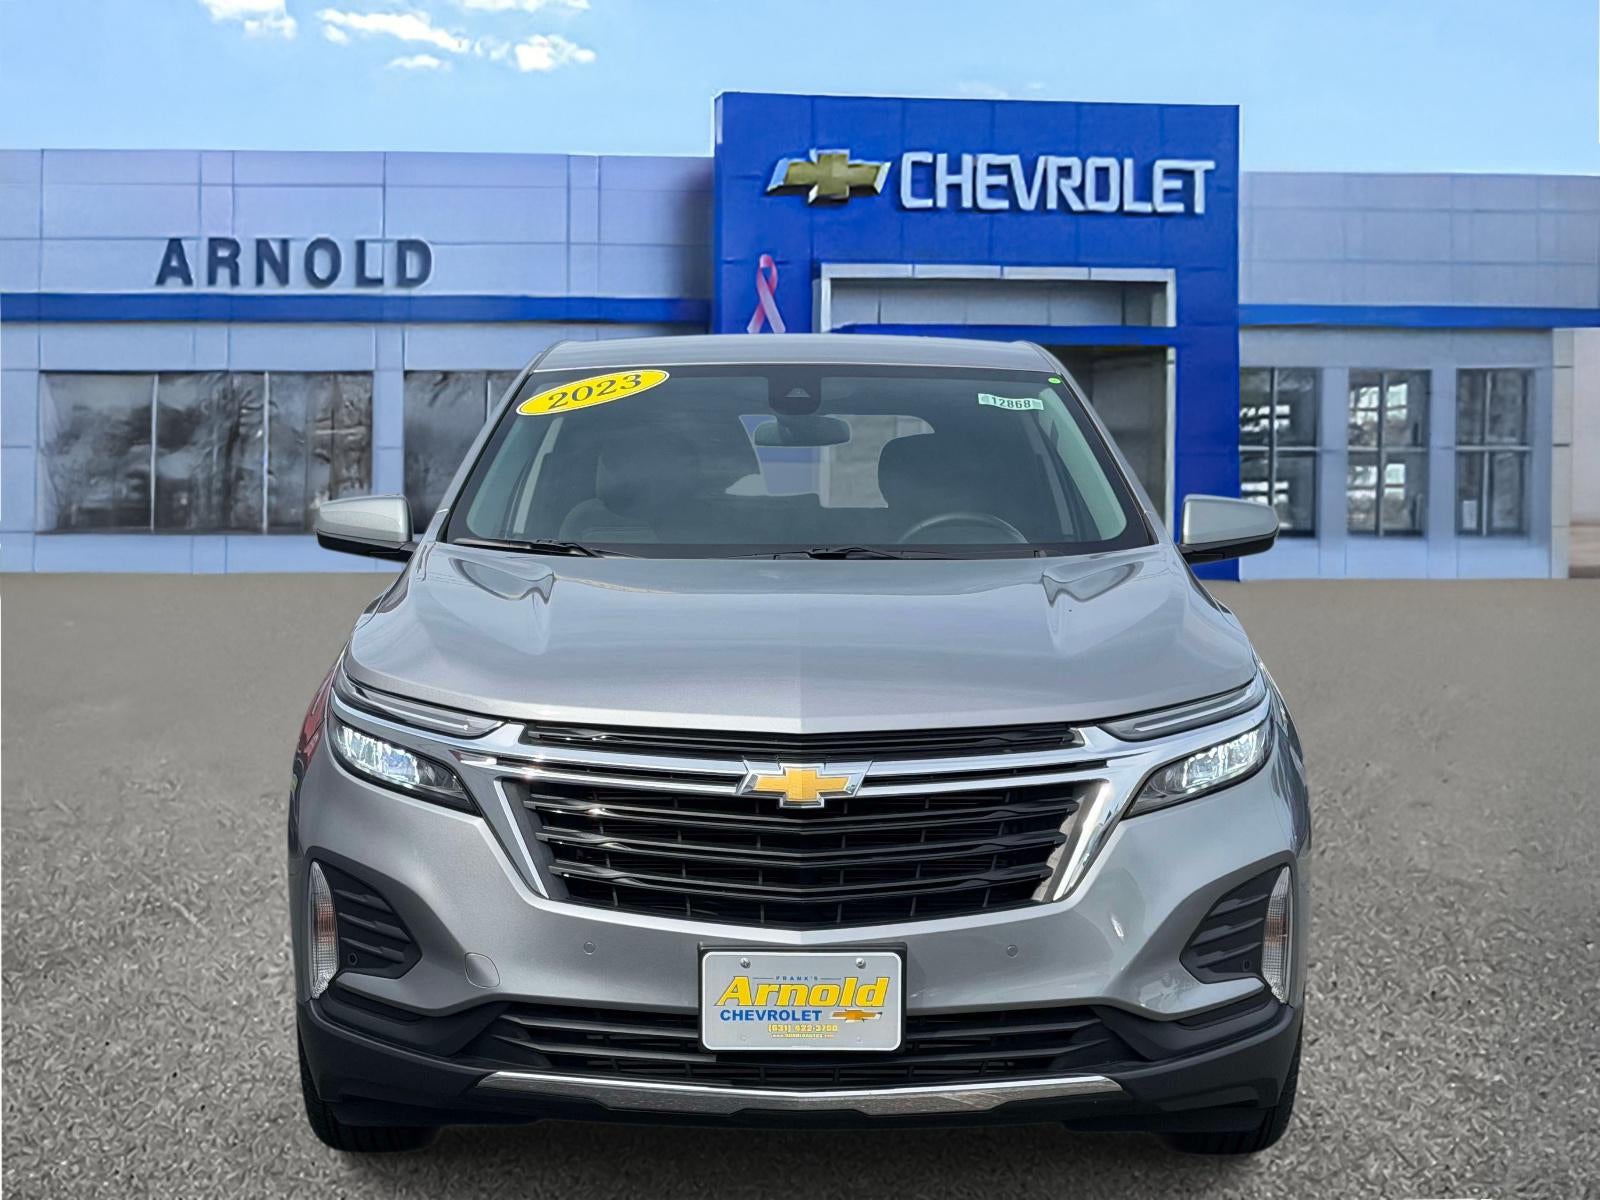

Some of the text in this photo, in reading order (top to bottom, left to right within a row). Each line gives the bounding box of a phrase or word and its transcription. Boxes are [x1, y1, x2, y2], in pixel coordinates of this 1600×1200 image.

[901, 151, 1216, 215] CHEVROLET
[154, 237, 433, 289] ARNOLD
[547, 374, 642, 411] 2023
[991, 396, 1031, 409] 12868
[714, 976, 890, 1007] Arnold
[720, 1010, 822, 1021] CHEVROLET
